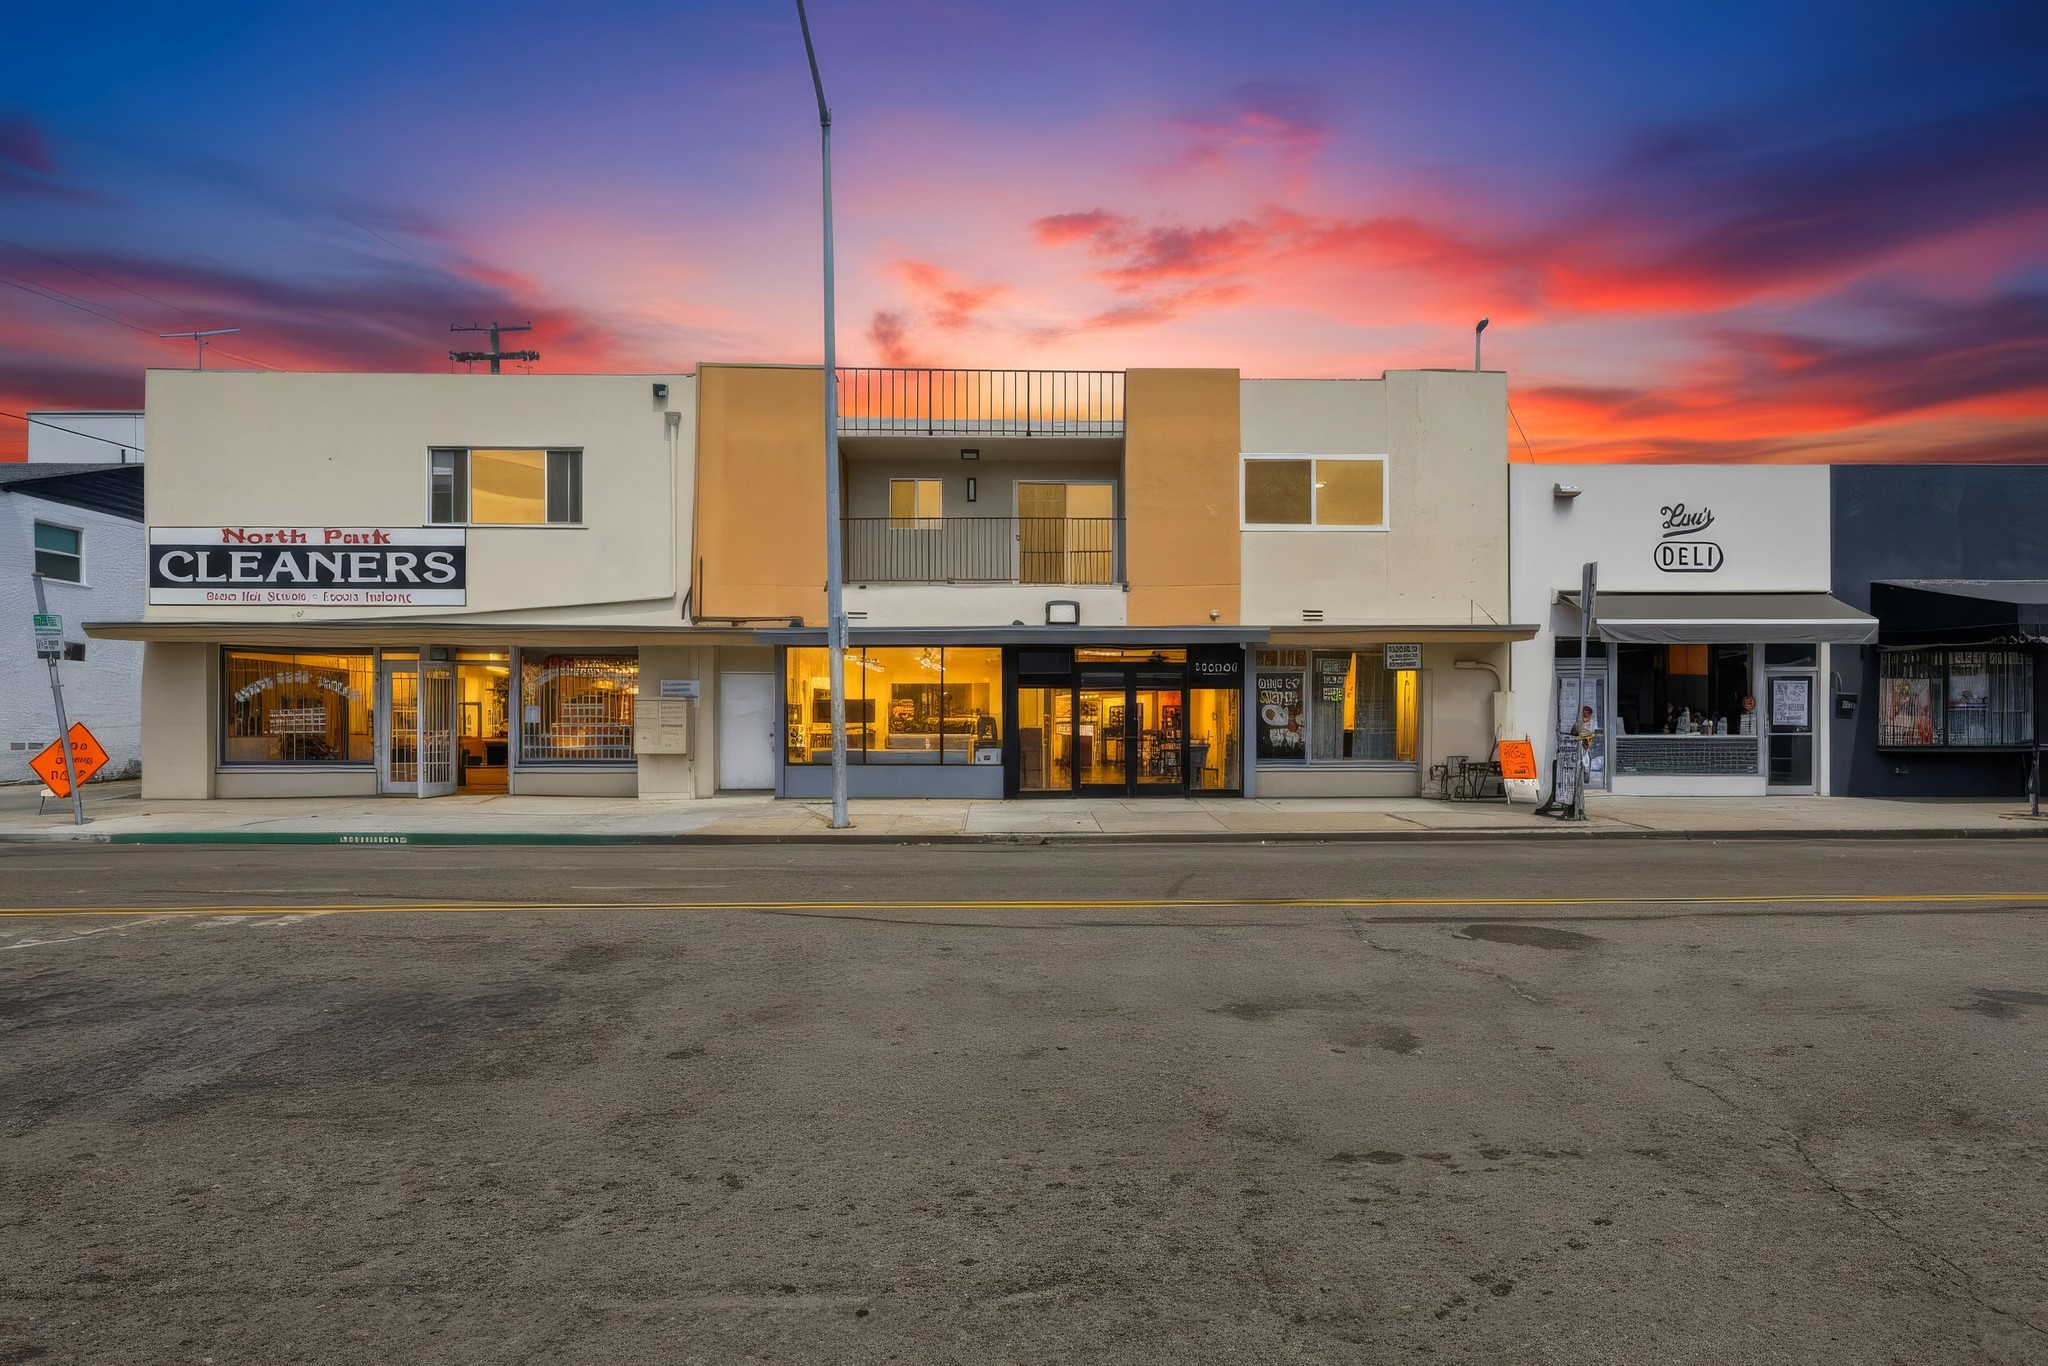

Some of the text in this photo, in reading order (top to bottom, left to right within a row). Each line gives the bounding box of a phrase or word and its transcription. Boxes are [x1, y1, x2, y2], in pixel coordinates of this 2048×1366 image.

[1660, 503, 1715, 538] Lou's
[222, 528, 391, 544] North Park
[158, 550, 457, 584] CLEANERS
[1662, 546, 1713, 566] DELI
